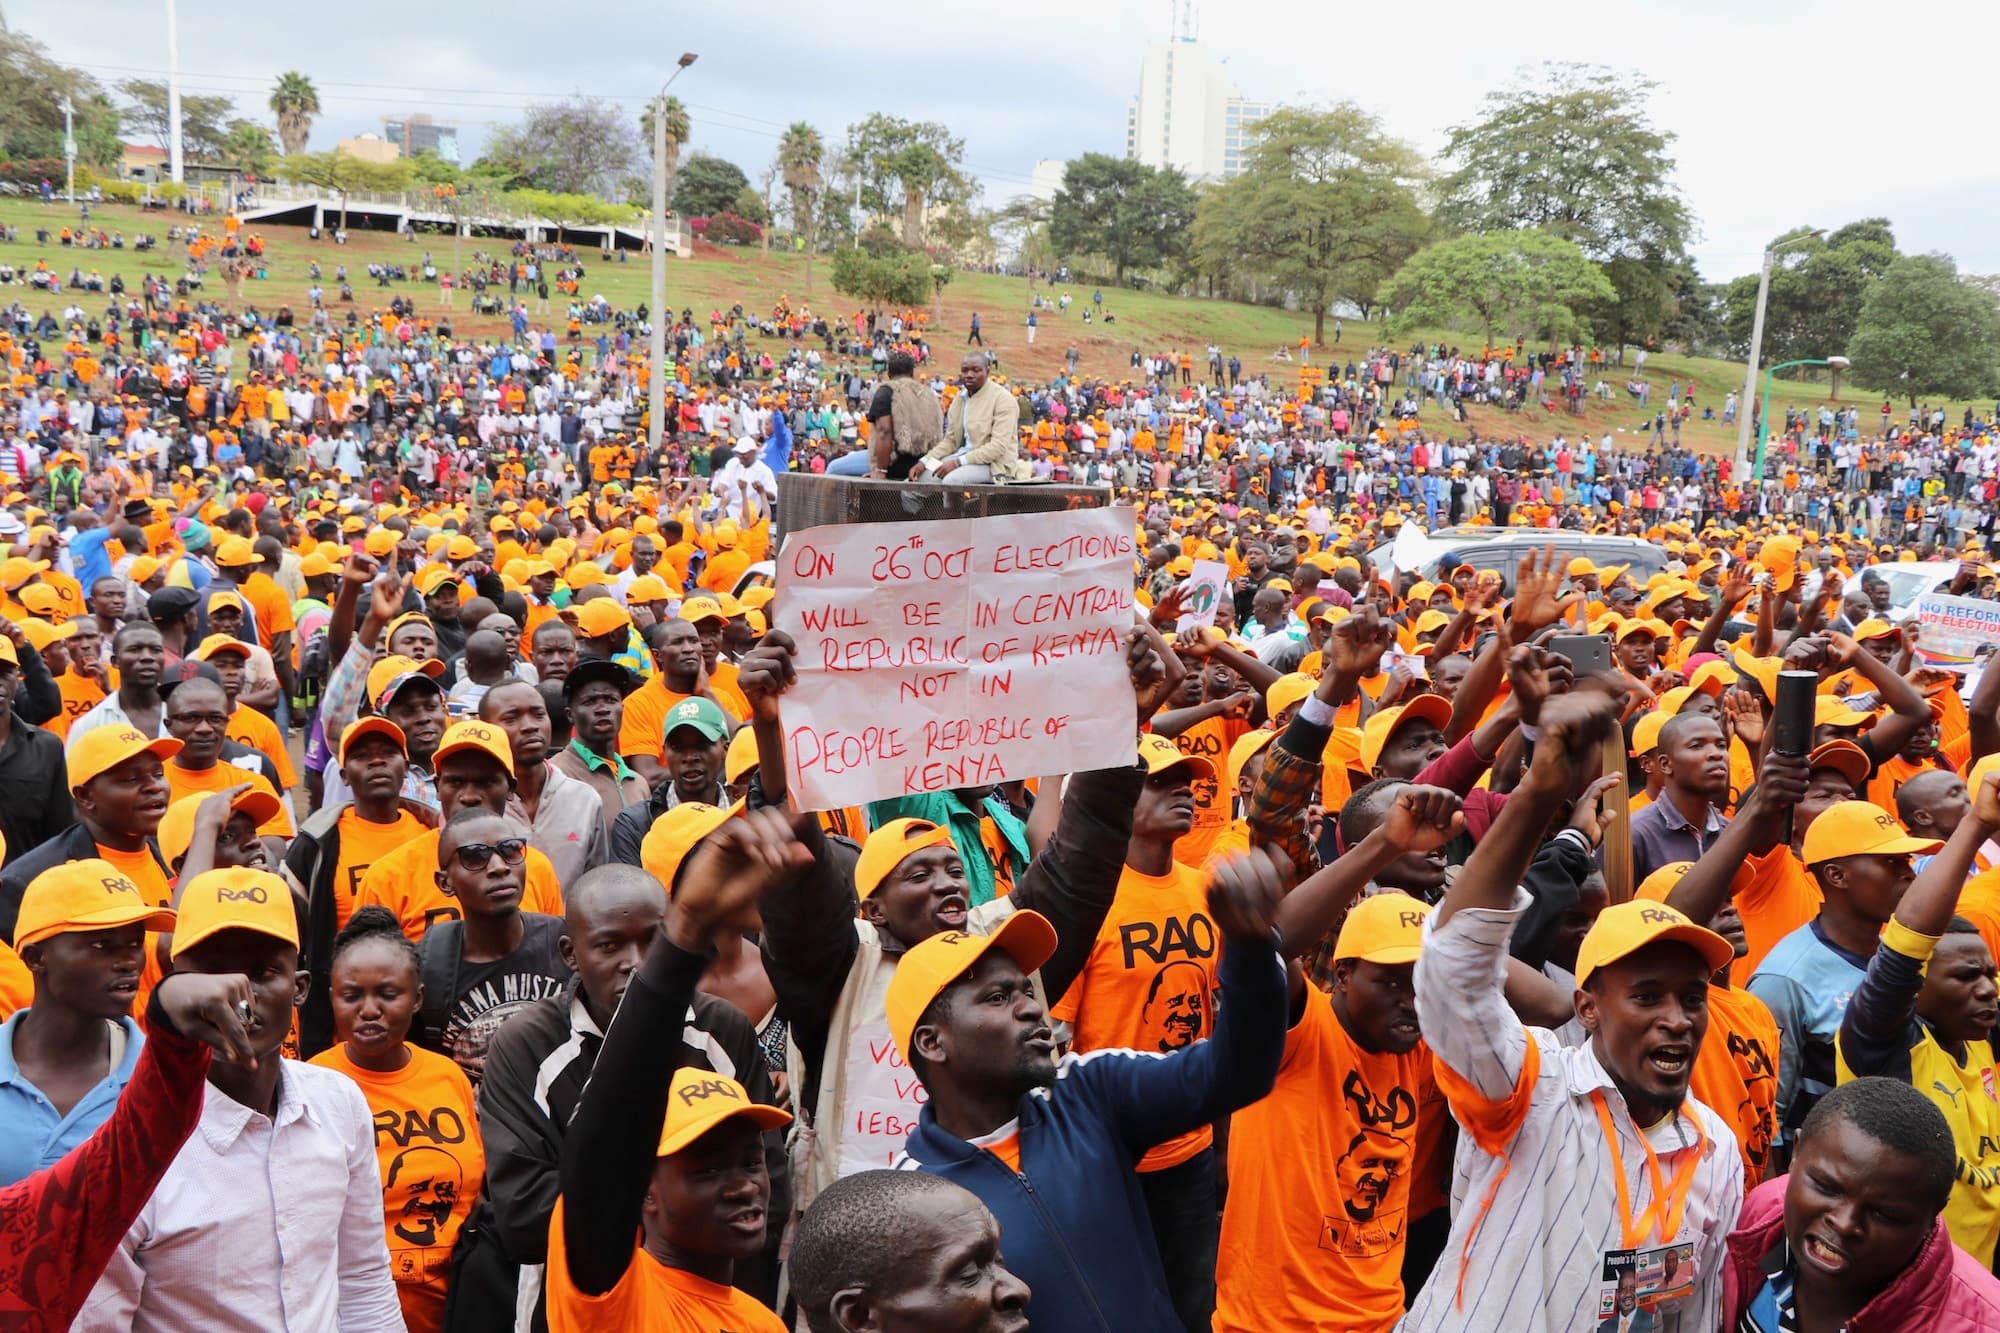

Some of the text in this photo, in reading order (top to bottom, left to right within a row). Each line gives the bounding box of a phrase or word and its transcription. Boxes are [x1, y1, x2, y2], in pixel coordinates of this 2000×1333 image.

[795, 545, 834, 579] ON
[924, 547, 974, 579] OCT
[994, 534, 1132, 573] ELECTIONS
[801, 587, 1131, 632] WILL BE IN CENTRAL
[1919, 603, 1941, 613] NO
[1919, 613, 2000, 632] NO ELECTIO
[819, 635, 968, 672] REPUBLIC
[982, 638, 1018, 663] OF
[901, 670, 1012, 704] NOT IN
[64, 701, 101, 716] RA
[456, 727, 491, 741] RAO
[1177, 734, 1222, 756] RAO
[789, 714, 1070, 790] PEOPLE REPUBLIC OF
[904, 754, 1006, 794] KENYA
[1874, 815, 1898, 830] RA
[217, 887, 267, 904] RAO
[1399, 911, 1426, 928] RA
[1119, 913, 1215, 969] RAO
[677, 1080, 739, 1107] RAO
[373, 1107, 465, 1147] RAO
